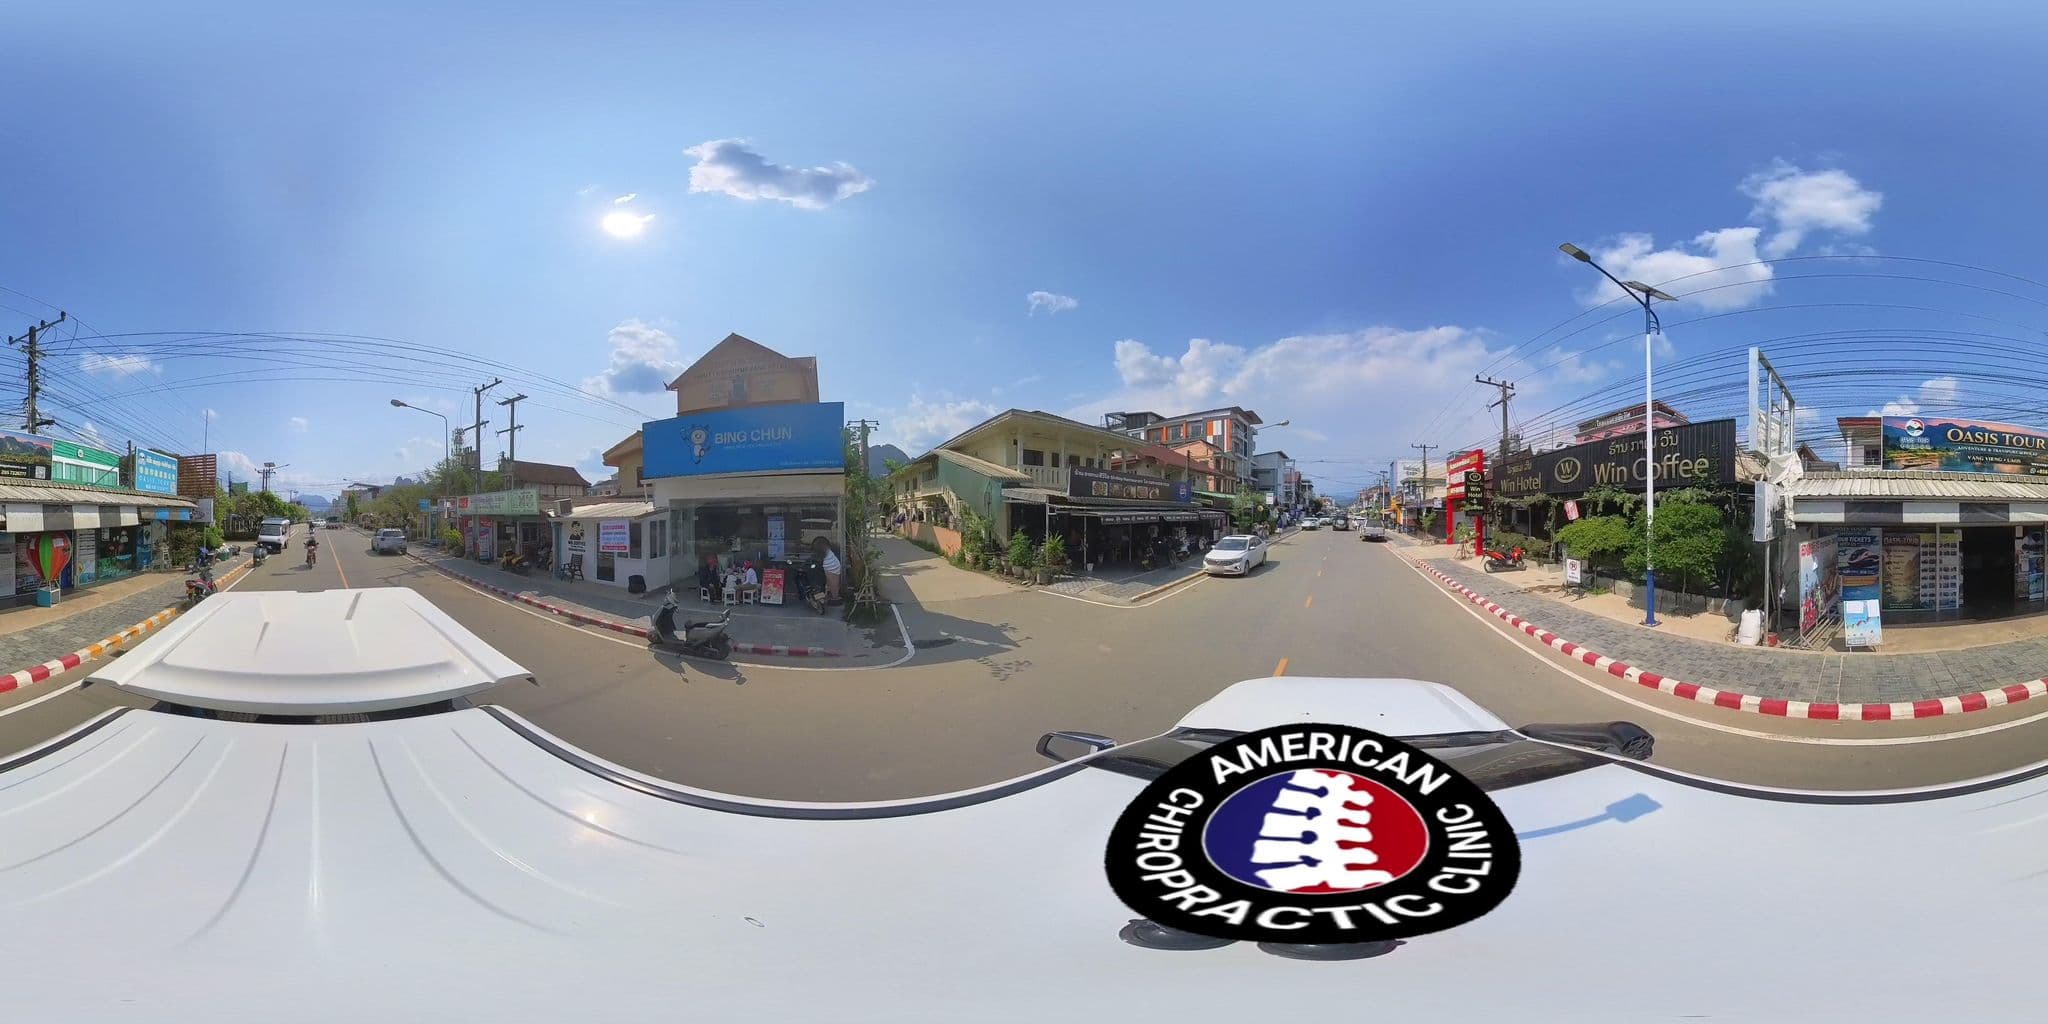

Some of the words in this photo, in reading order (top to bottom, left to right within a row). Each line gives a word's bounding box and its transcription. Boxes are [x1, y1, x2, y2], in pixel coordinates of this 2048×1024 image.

[714, 431, 747, 444] BING
[750, 427, 793, 441] CHUN
[1947, 428, 1998, 445] OASIS
[2002, 433, 2046, 449] TOUR
[1561, 461, 1573, 475] W
[1593, 462, 1628, 483] Win
[1632, 453, 1709, 481] Coffee
[1500, 479, 1515, 493] Win
[1516, 471, 1542, 491] Hotel
